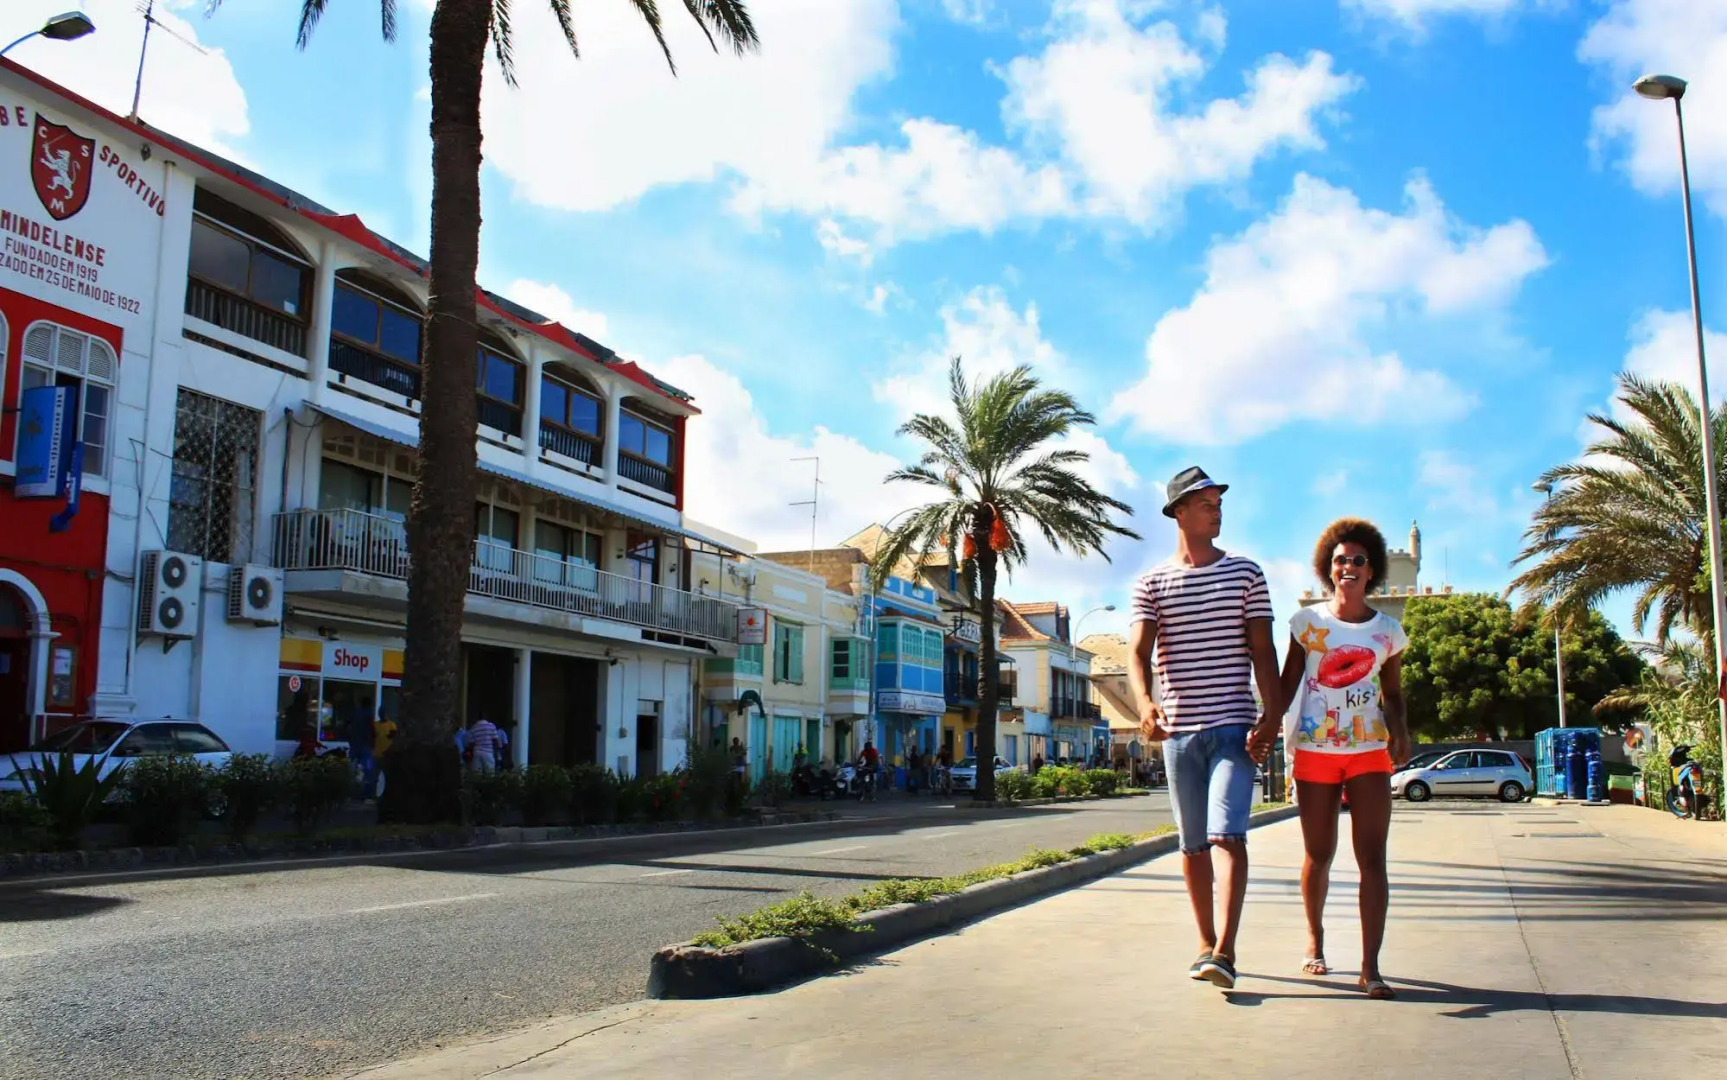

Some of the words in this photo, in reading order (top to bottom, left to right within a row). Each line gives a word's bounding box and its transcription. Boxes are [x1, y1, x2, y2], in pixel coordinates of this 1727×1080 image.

[38, 126, 48, 138] C
[81, 144, 90, 158] S
[99, 145, 165, 217] SPORTIVO
[50, 198, 65, 213] M
[0, 209, 106, 267] MINDELENSE
[5, 237, 59, 269] FUNDADO
[60, 257, 75, 275] EM
[76, 263, 98, 283] 1919
[29, 263, 45, 281] EM
[46, 269, 61, 286] 25
[62, 275, 76, 292] DE
[77, 280, 102, 301] MAIO
[102, 289, 116, 306] DE
[117, 295, 140, 315] 1922
[334, 648, 369, 673] Shop
